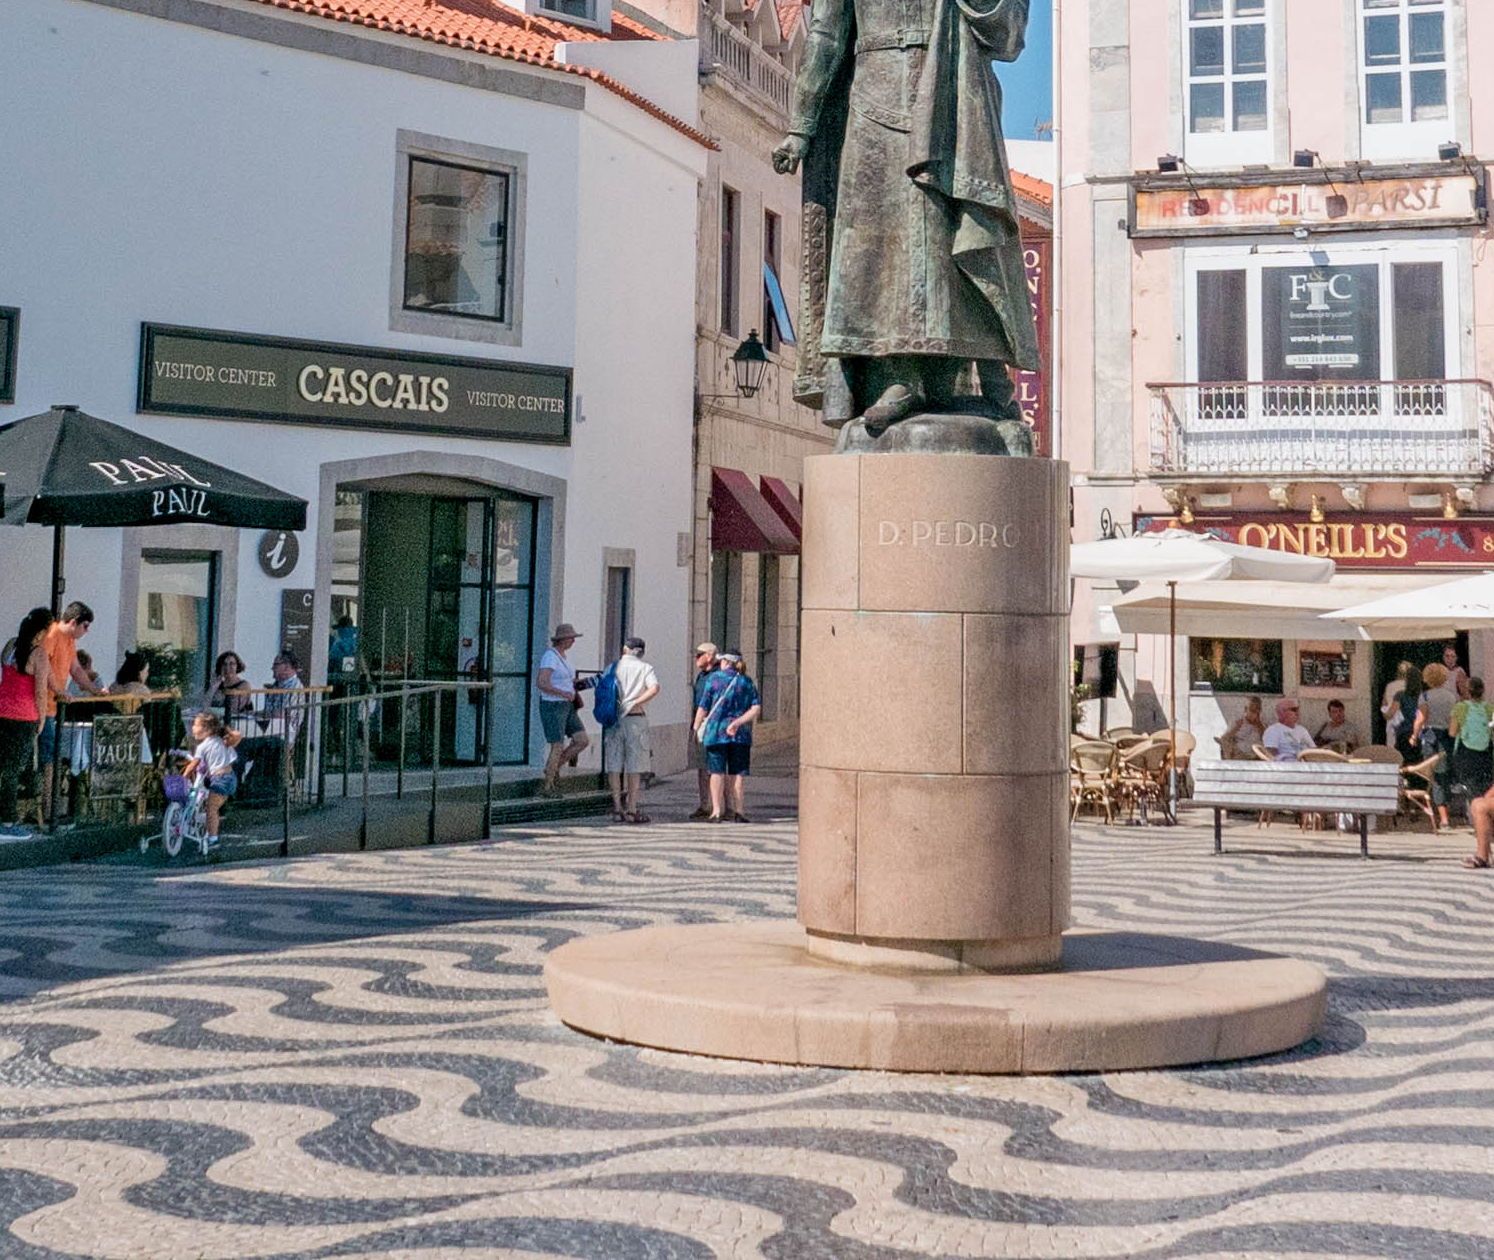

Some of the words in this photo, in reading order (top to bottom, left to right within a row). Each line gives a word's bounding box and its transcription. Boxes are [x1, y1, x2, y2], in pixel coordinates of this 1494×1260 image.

[155, 361, 214, 383] VISITOR
[218, 367, 276, 388] CENTER
[299, 364, 449, 413] CASCAIS
[467, 390, 516, 409] VISITOR
[518, 394, 565, 413] CENTER
[89, 456, 211, 487] PAUL
[152, 488, 211, 517] PAUL
[912, 520, 1020, 548] PEDRO
[1238, 522, 1408, 560] O'NEILL'S
[97, 743, 138, 765] PAUL
